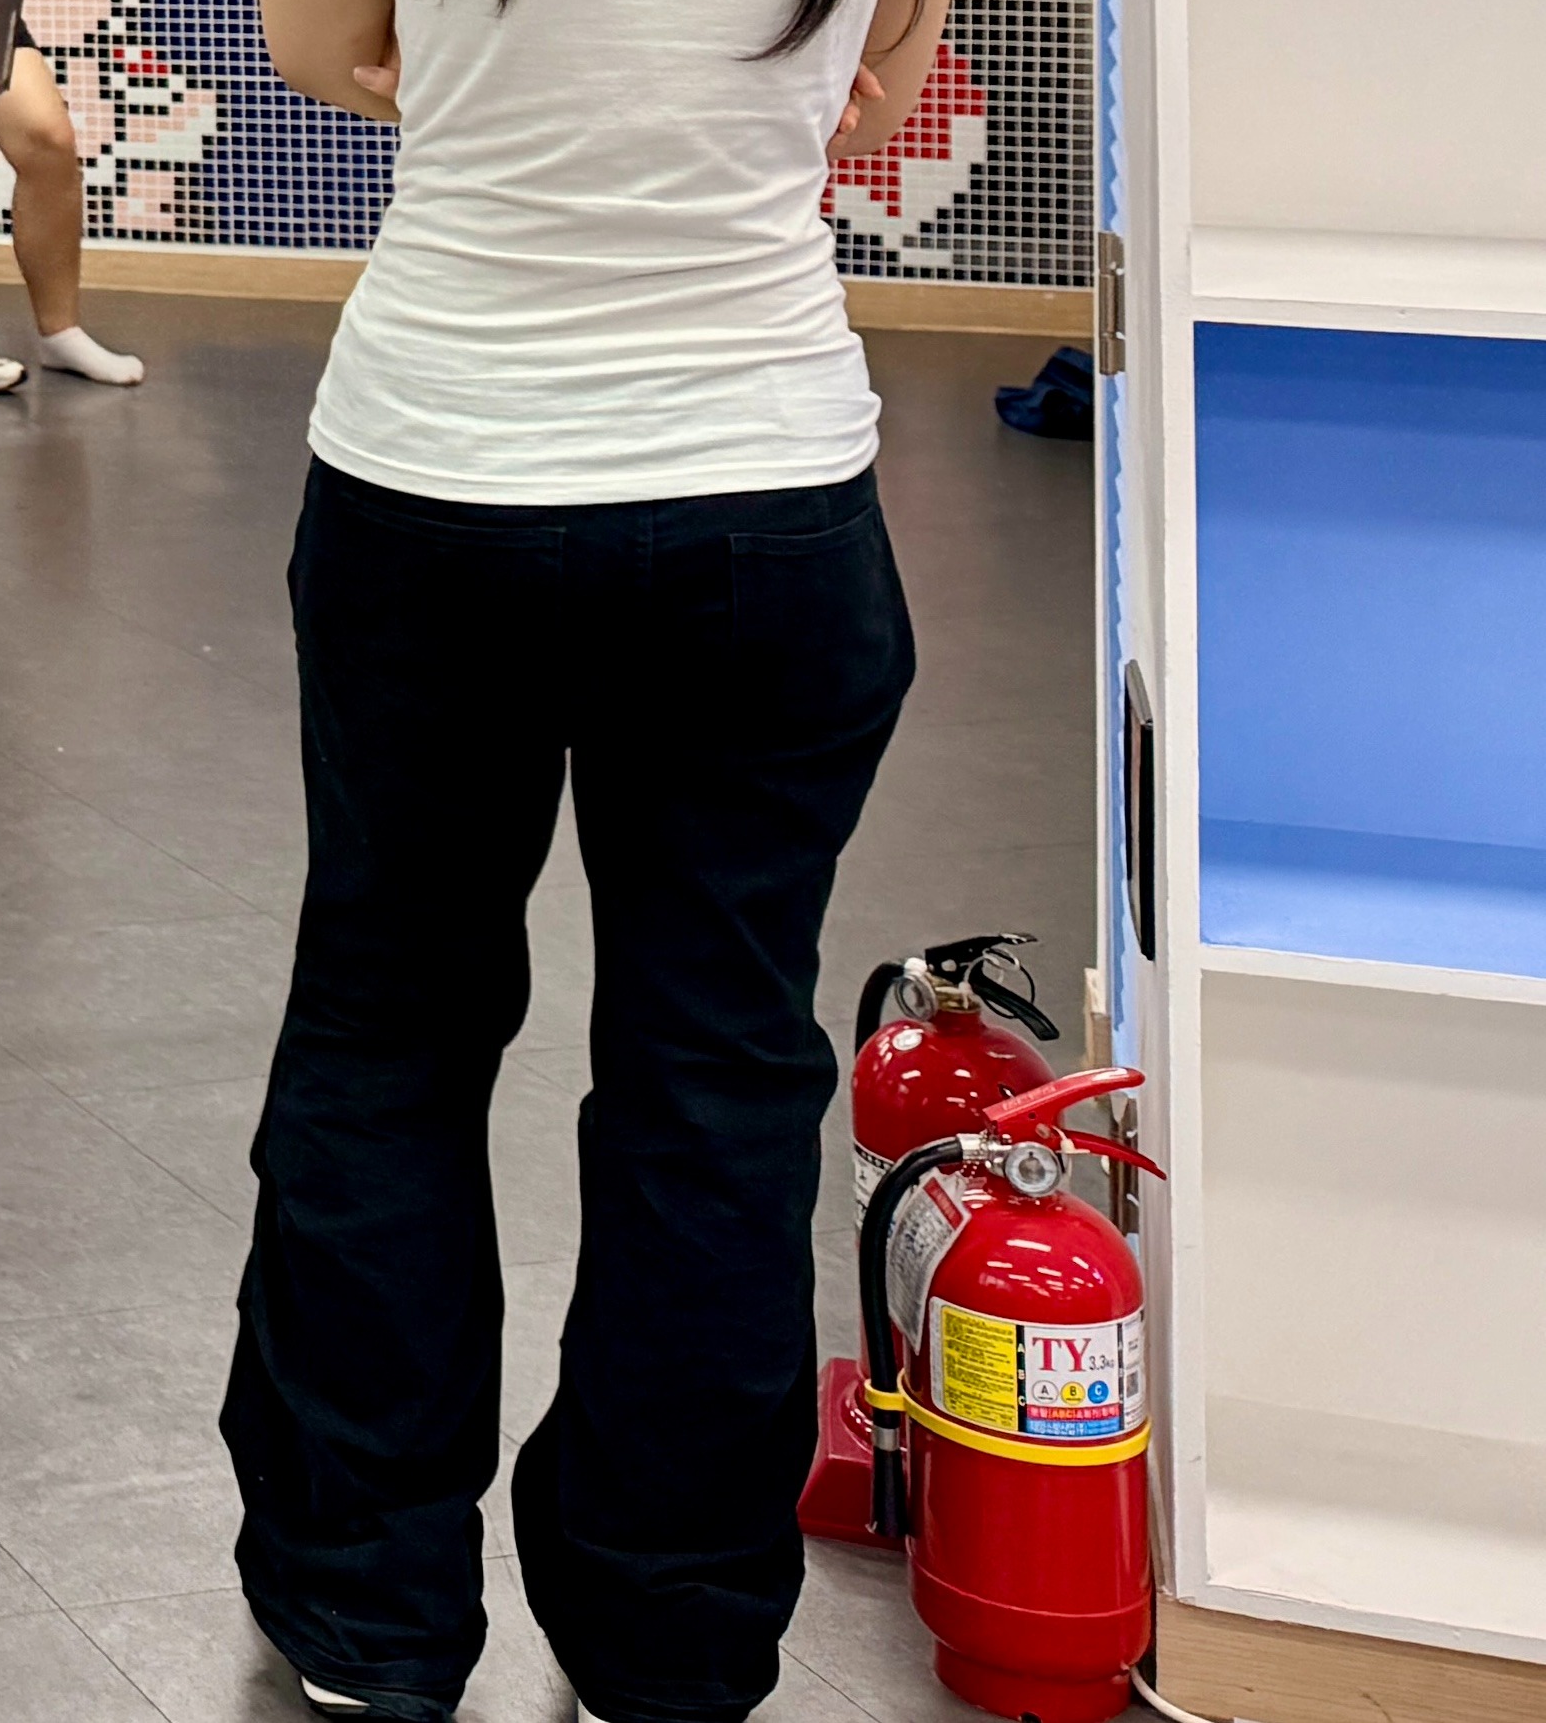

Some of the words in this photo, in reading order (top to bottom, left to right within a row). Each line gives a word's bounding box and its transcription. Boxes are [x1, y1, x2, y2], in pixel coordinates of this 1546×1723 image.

[1032, 1337, 1092, 1372] TY
[1041, 1385, 1049, 1395] A
[1069, 1386, 1077, 1396] B
